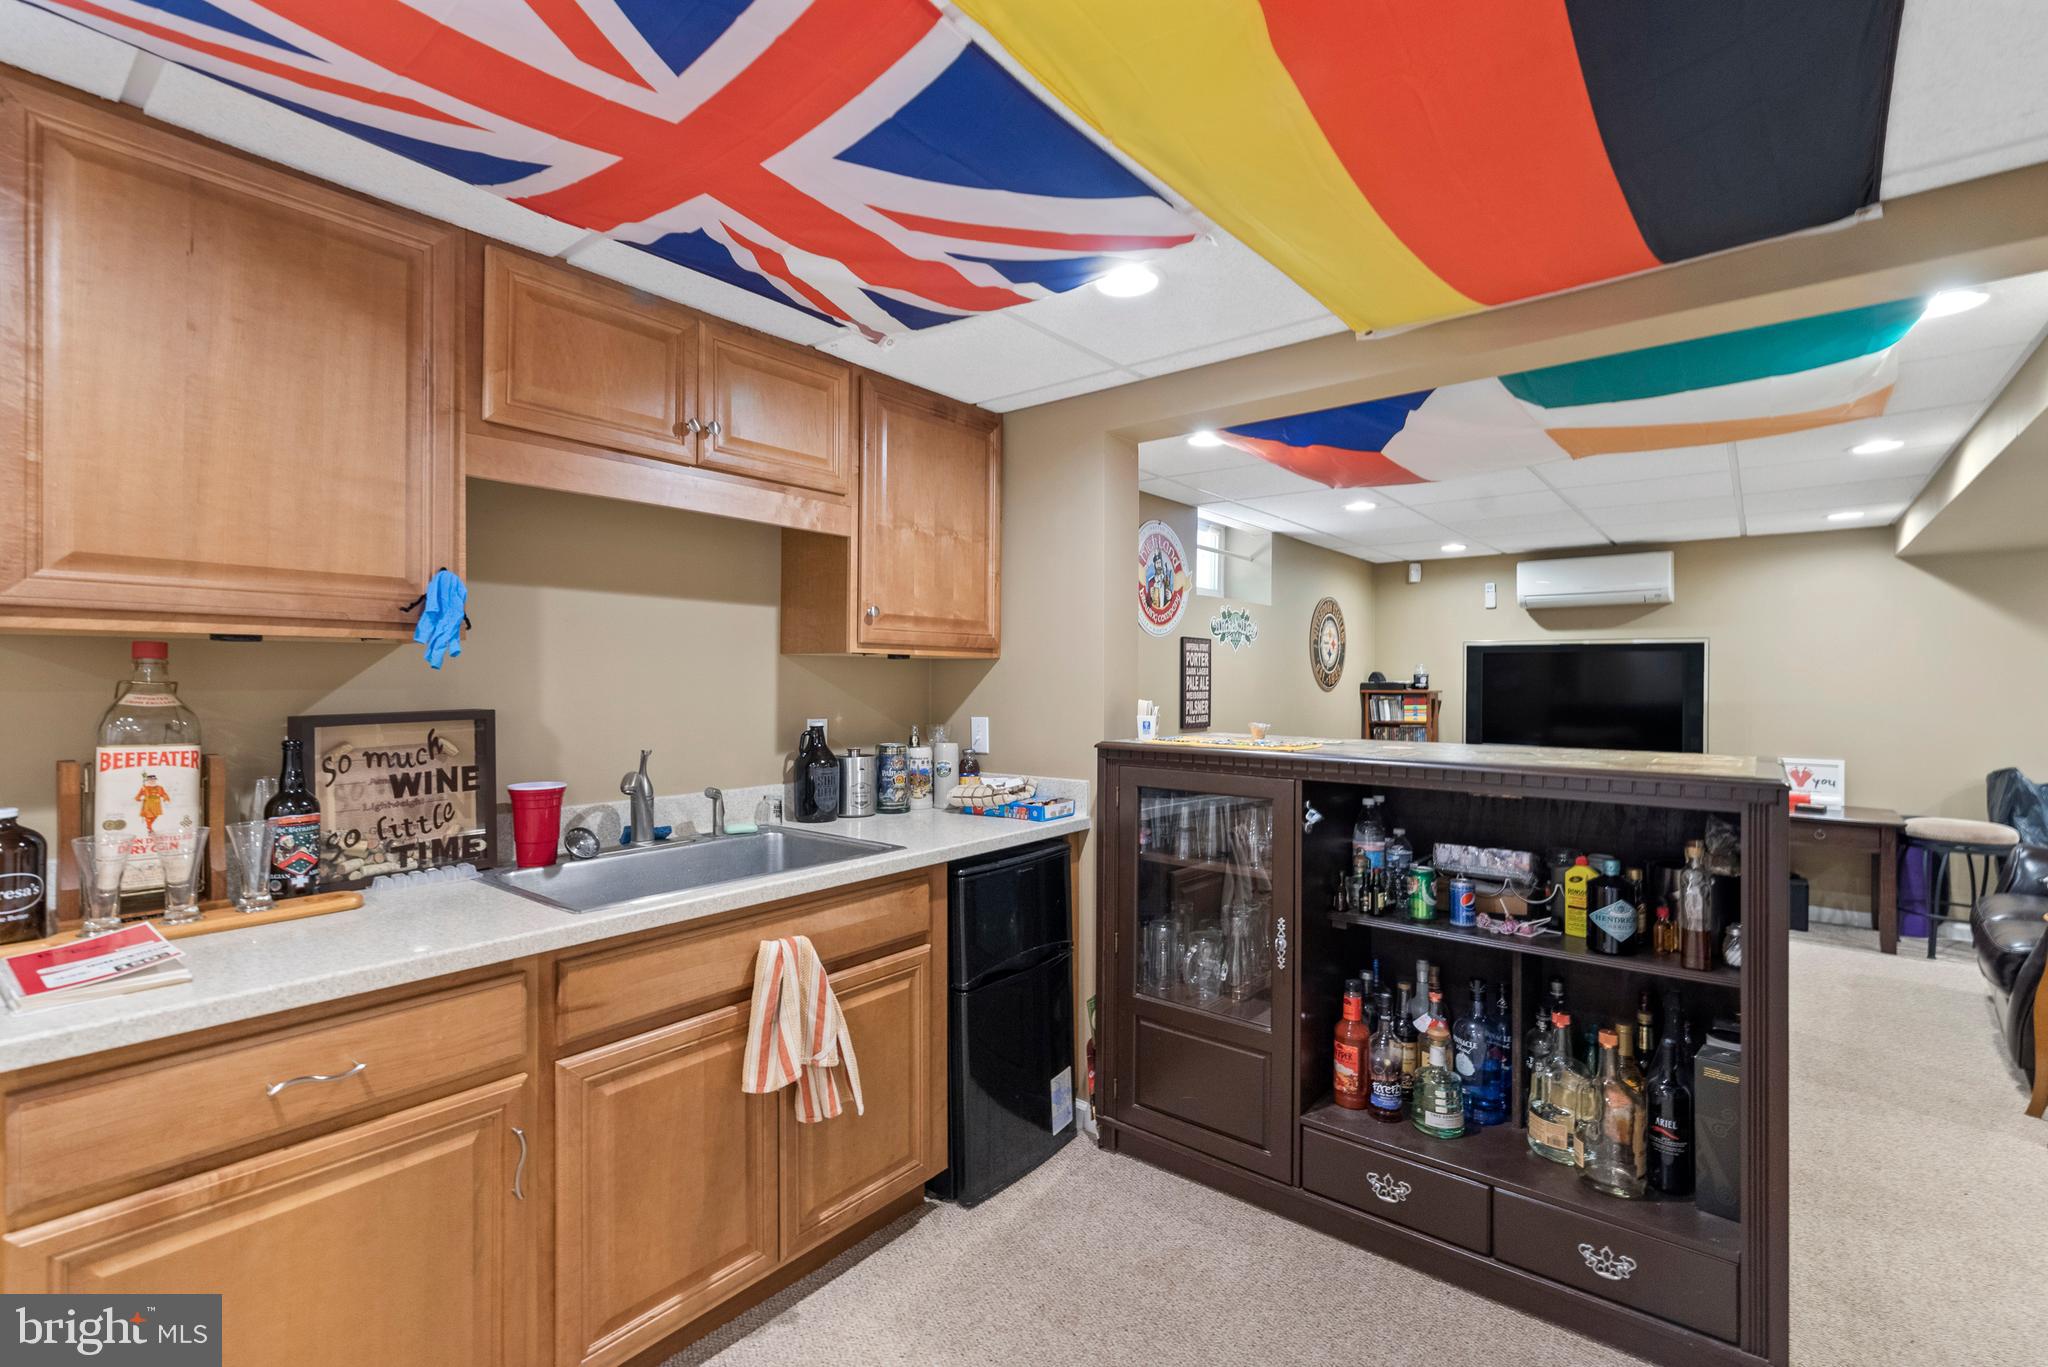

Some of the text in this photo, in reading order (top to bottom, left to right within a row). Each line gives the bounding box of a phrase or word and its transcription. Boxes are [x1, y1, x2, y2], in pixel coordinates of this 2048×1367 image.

[1157, 594, 1181, 623] company
[1186, 652, 1209, 667] PORTER
[1186, 667, 1209, 675] DARK LAGER
[1186, 676, 1209, 691] PALE ALE
[1186, 700, 1209, 715] PILSNER
[1185, 714, 1209, 724] PALE LAGER
[362, 728, 444, 769] much
[99, 750, 200, 773] BEEFEATER
[389, 765, 480, 799] WINE
[1812, 778, 1836, 789] you
[377, 802, 456, 841] little
[389, 834, 488, 869] TIME
[1655, 1117, 1678, 1130] ARIEL
